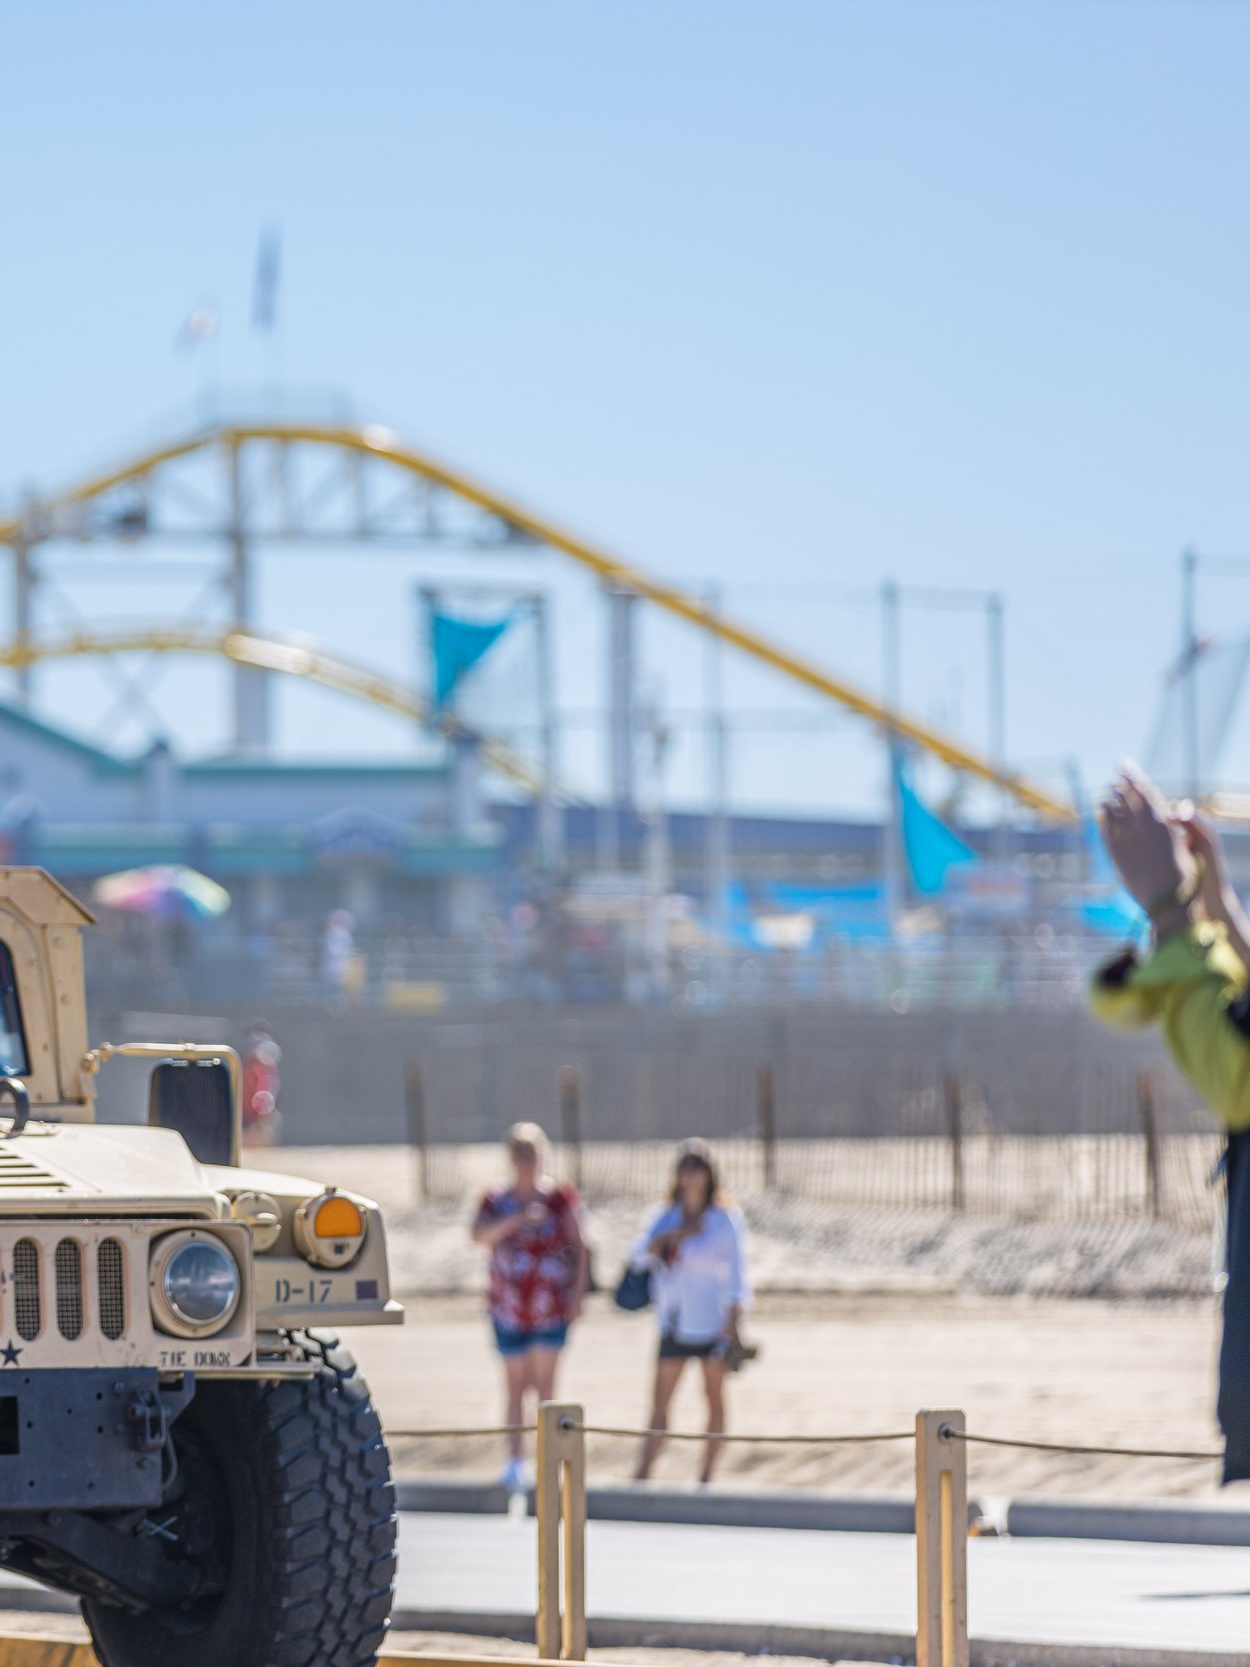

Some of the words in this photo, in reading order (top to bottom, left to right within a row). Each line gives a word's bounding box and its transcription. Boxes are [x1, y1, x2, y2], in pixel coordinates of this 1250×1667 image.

[275, 1279, 333, 1303] D-17
[159, 1350, 187, 1368] TIE
[193, 1350, 232, 1368] DOWN
